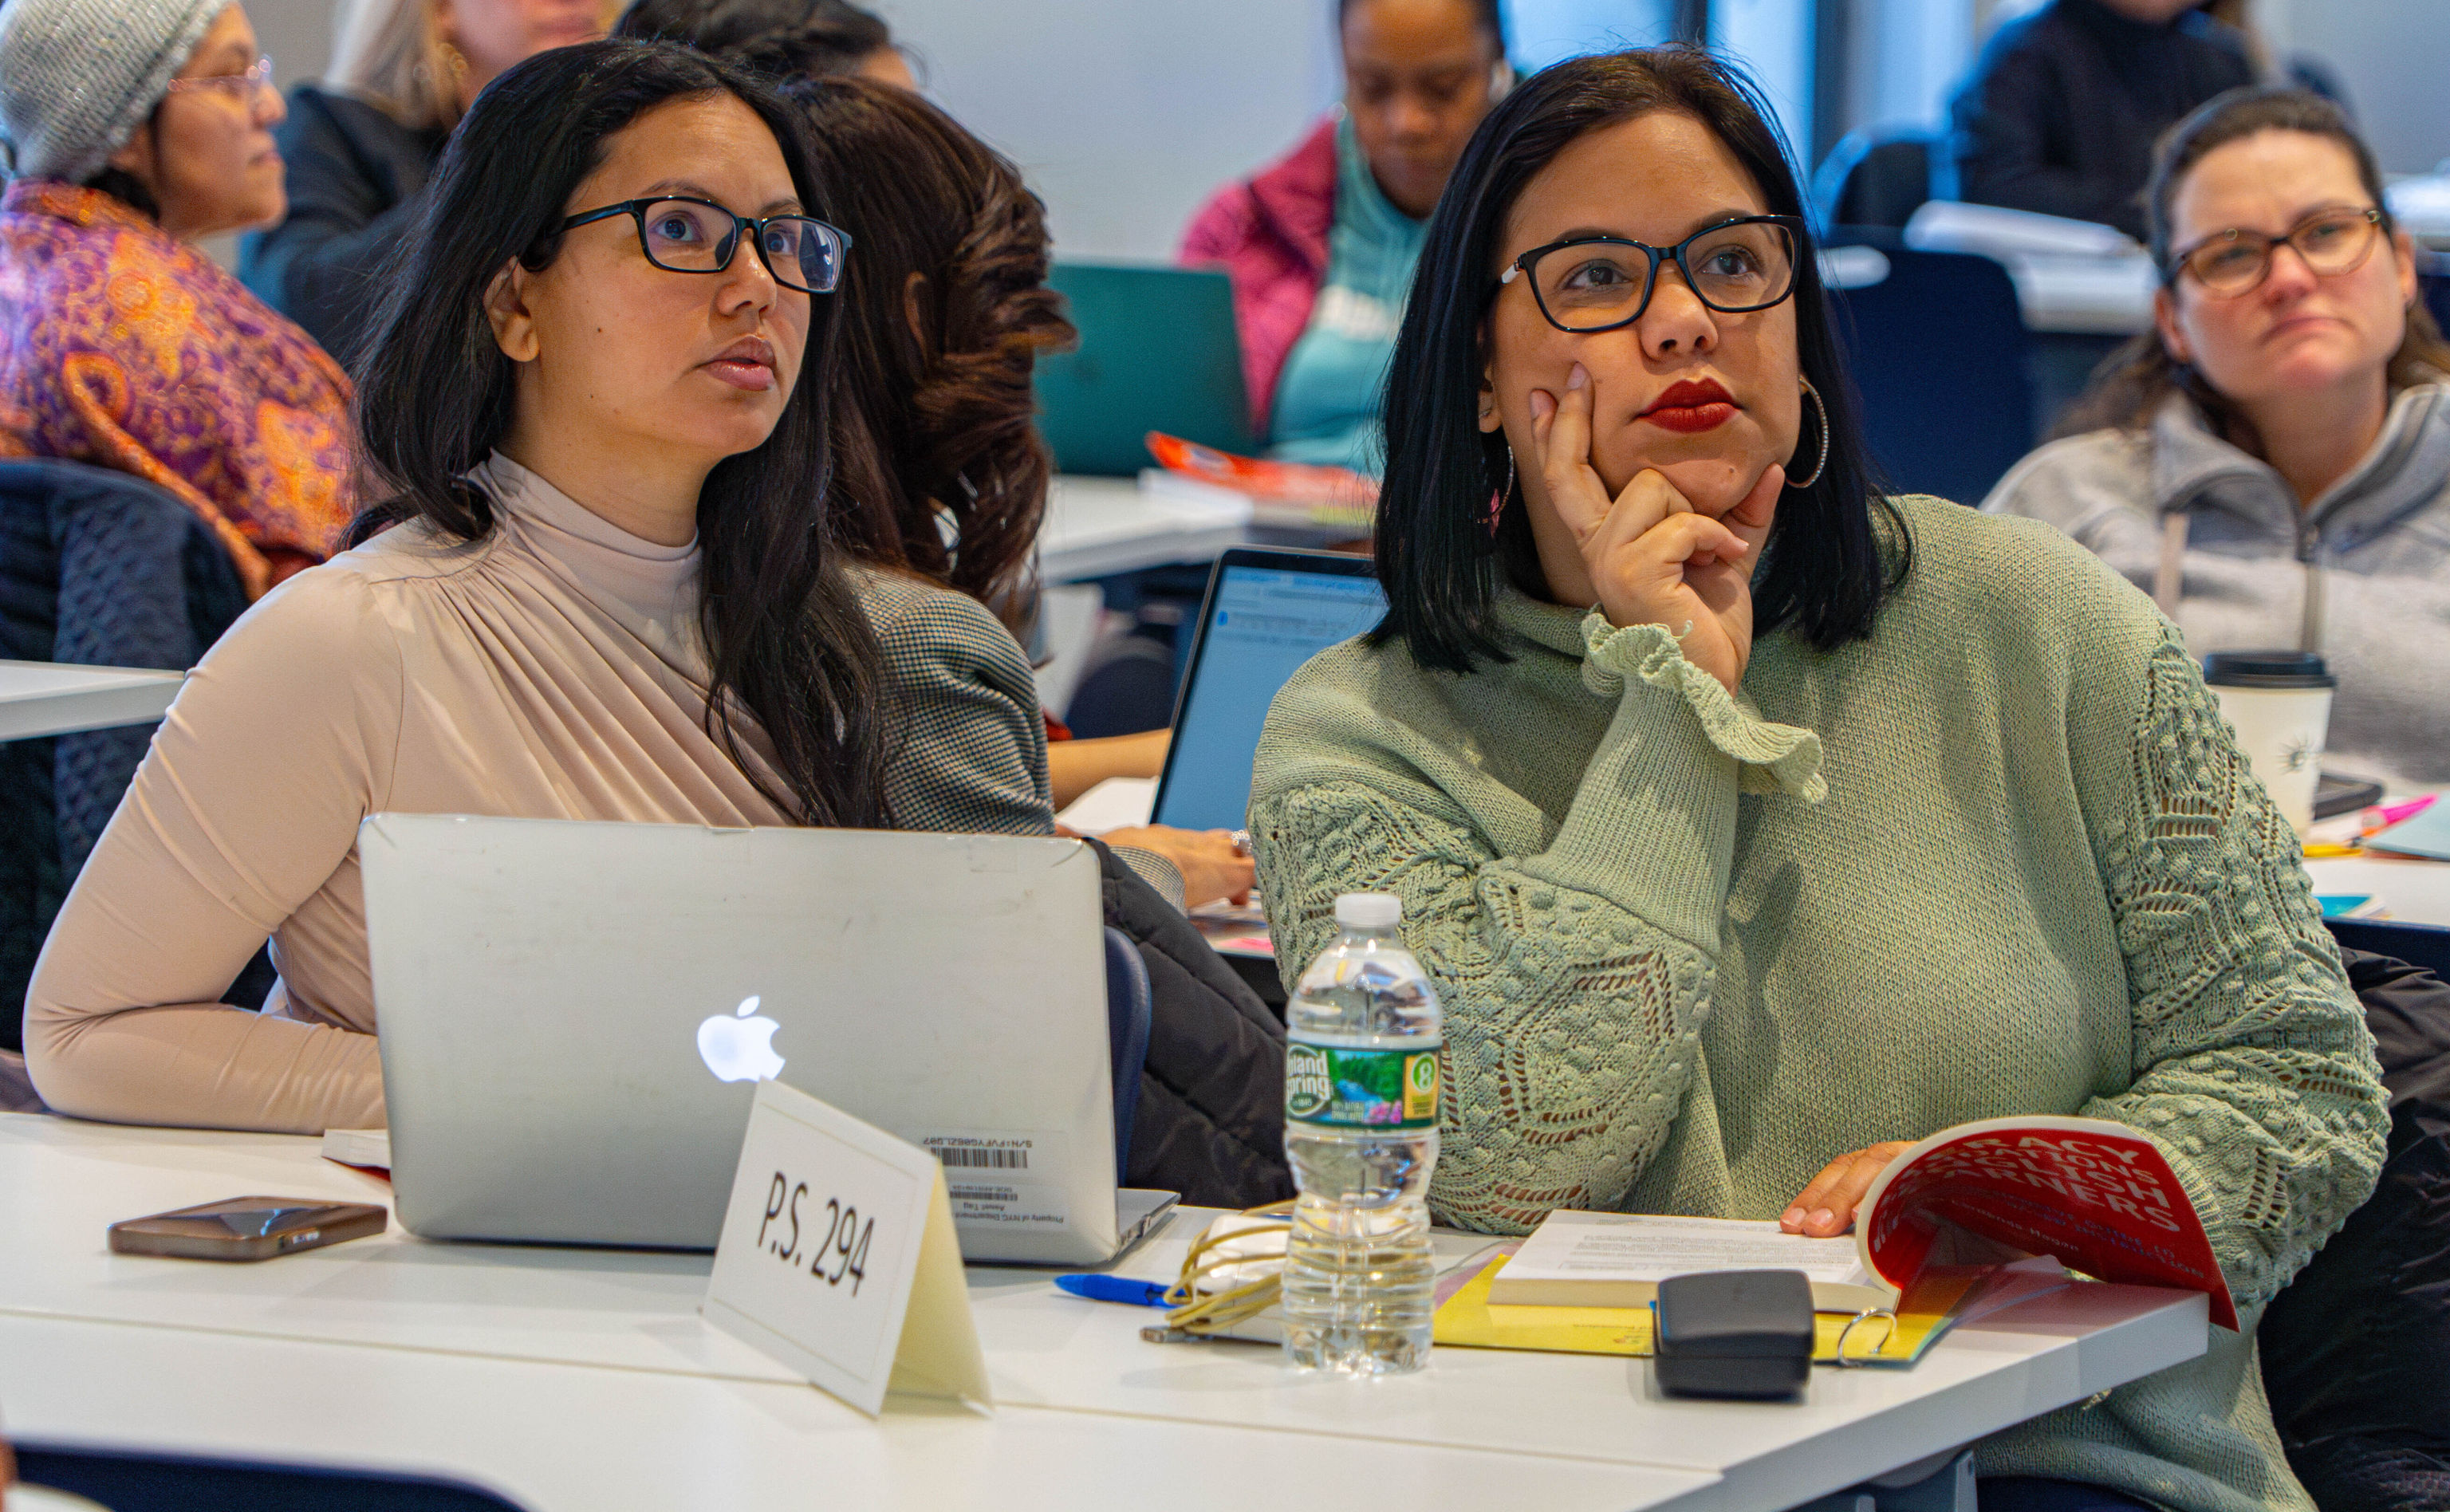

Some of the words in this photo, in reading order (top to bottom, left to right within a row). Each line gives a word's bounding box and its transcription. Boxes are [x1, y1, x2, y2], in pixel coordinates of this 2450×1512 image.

[1287, 1075, 1330, 1104] pring
[1930, 1167, 2180, 1232] ARNERS
[955, 1212, 1000, 1222] Department
[1002, 1213, 1020, 1222] NYC
[1033, 1214, 1065, 1224] Property
[758, 1171, 808, 1267] P.S.
[810, 1198, 874, 1297] 294
